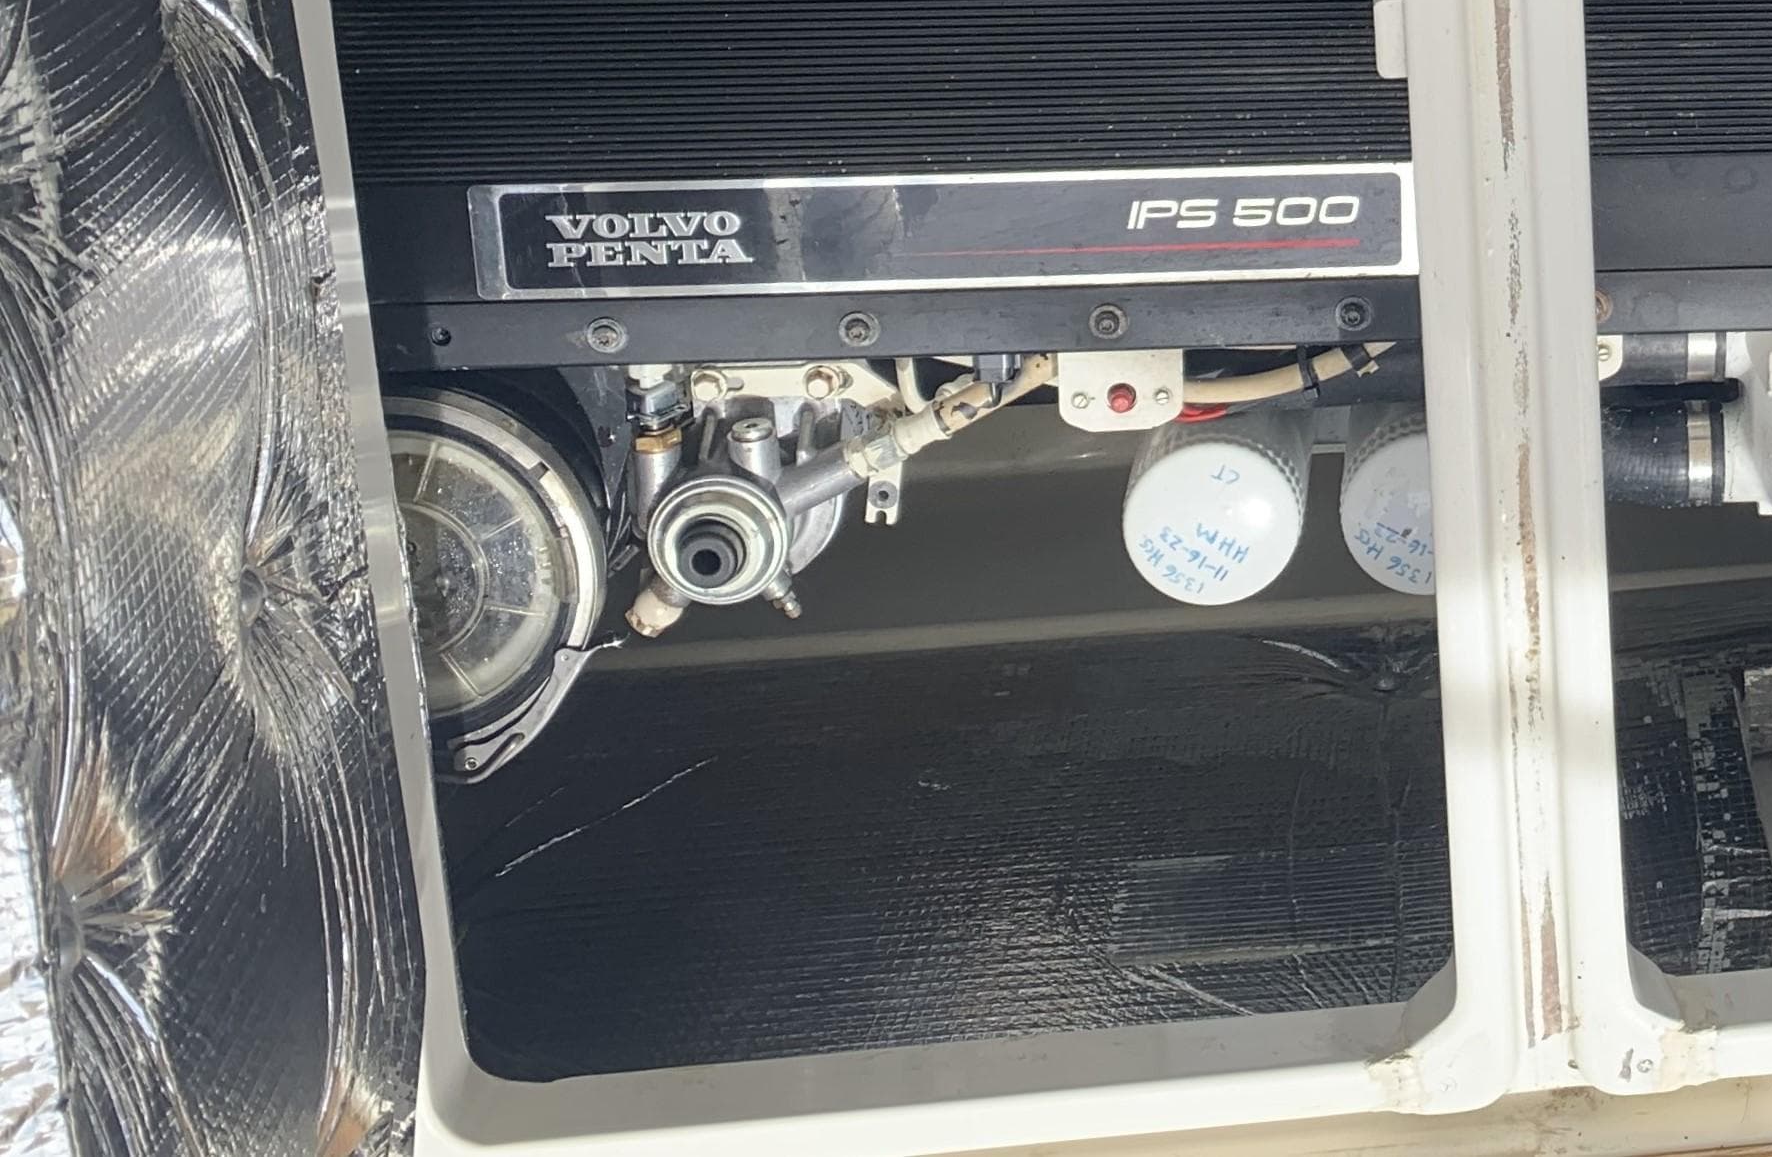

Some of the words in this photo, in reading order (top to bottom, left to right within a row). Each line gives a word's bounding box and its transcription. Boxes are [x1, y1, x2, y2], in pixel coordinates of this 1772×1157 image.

[546, 210, 742, 241] VOLVO
[1127, 200, 1216, 232] IPS
[1231, 196, 1361, 229] 500
[546, 238, 754, 268] PENTA
[1211, 465, 1240, 485] CT
[1159, 526, 1229, 582] 11-16-23
[1162, 565, 1205, 594] 1356
[1386, 556, 1432, 584] 1356
